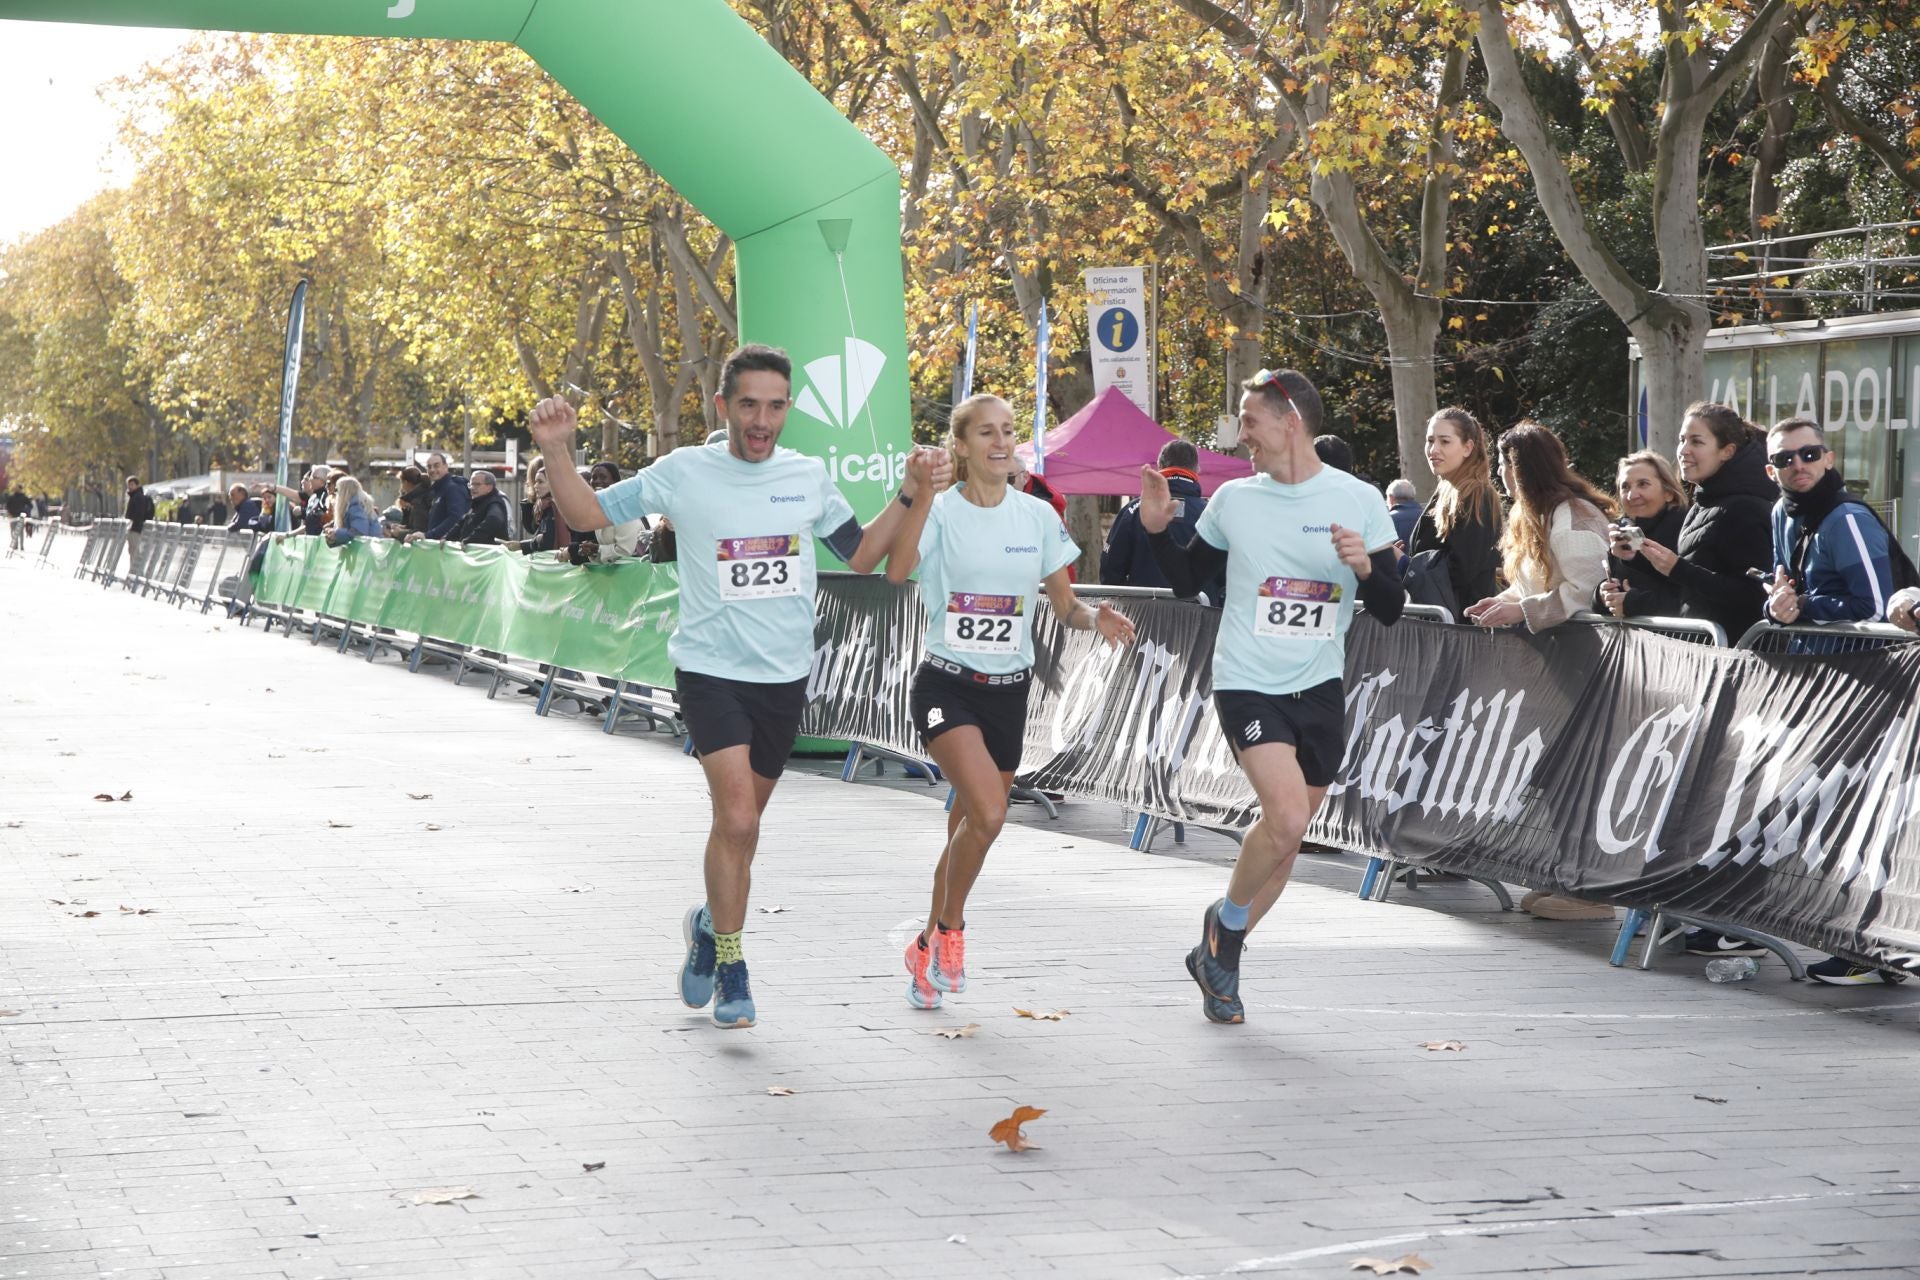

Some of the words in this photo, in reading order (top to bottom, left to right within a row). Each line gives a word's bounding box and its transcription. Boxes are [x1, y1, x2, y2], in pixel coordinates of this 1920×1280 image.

[1092, 276, 1118, 284] Oficina
[828, 443, 906, 491] icaja
[770, 495, 806, 503] OneHealth
[1302, 525, 1329, 533] OneHe
[1005, 545, 1038, 553] OneHealth
[731, 560, 788, 587] 823
[1268, 601, 1324, 628] 821
[957, 616, 1012, 642] 822
[925, 653, 961, 674] S2O
[1597, 703, 1705, 863] El
